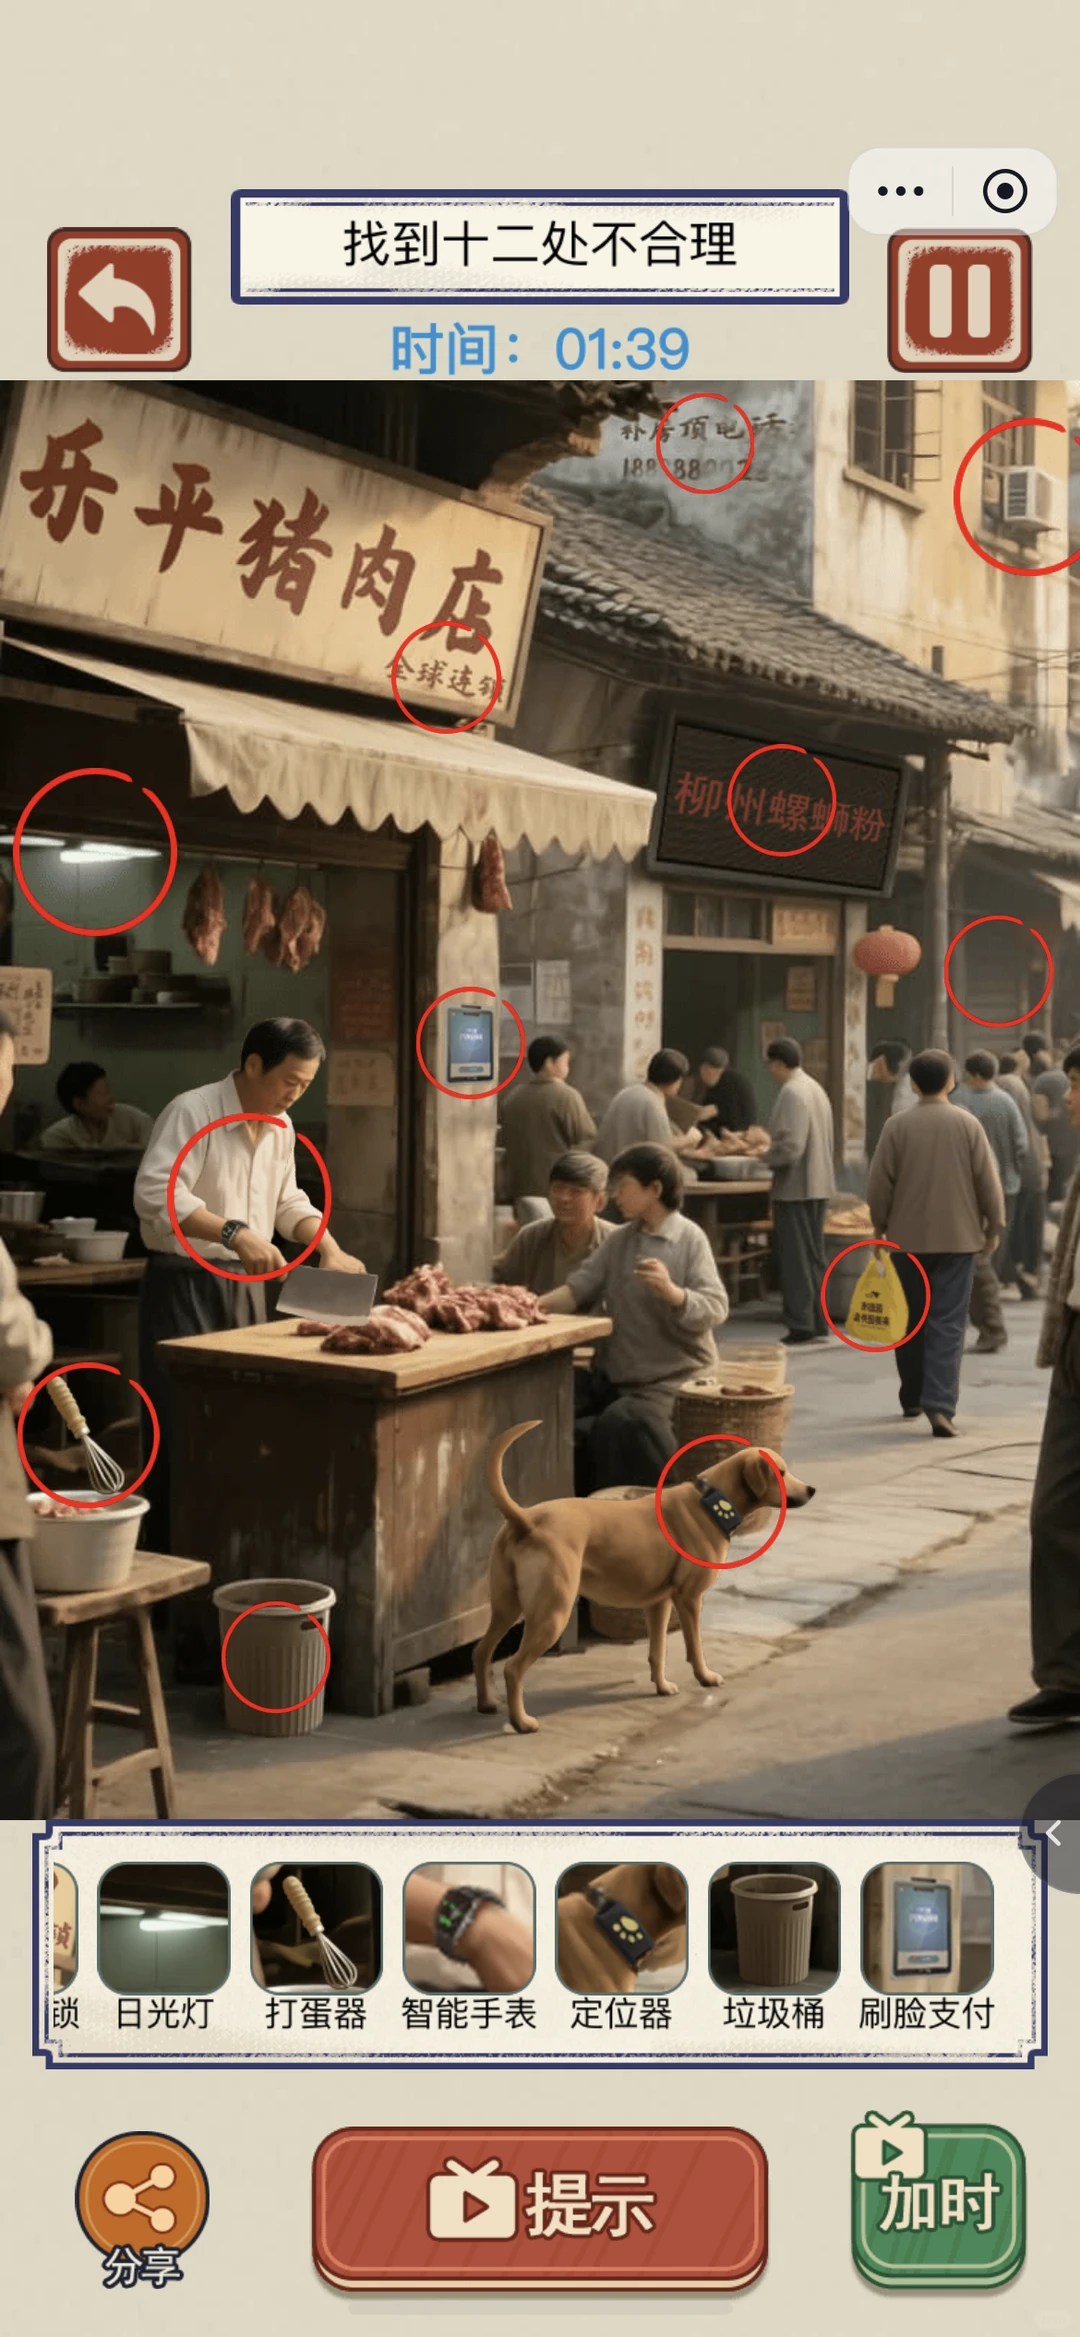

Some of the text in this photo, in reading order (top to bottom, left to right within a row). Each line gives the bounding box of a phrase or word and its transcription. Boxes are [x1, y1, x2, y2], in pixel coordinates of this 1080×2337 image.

[20, 418, 504, 655] 乐平猪肉店
[674, 771, 885, 842] 柳州螺蛳粉
